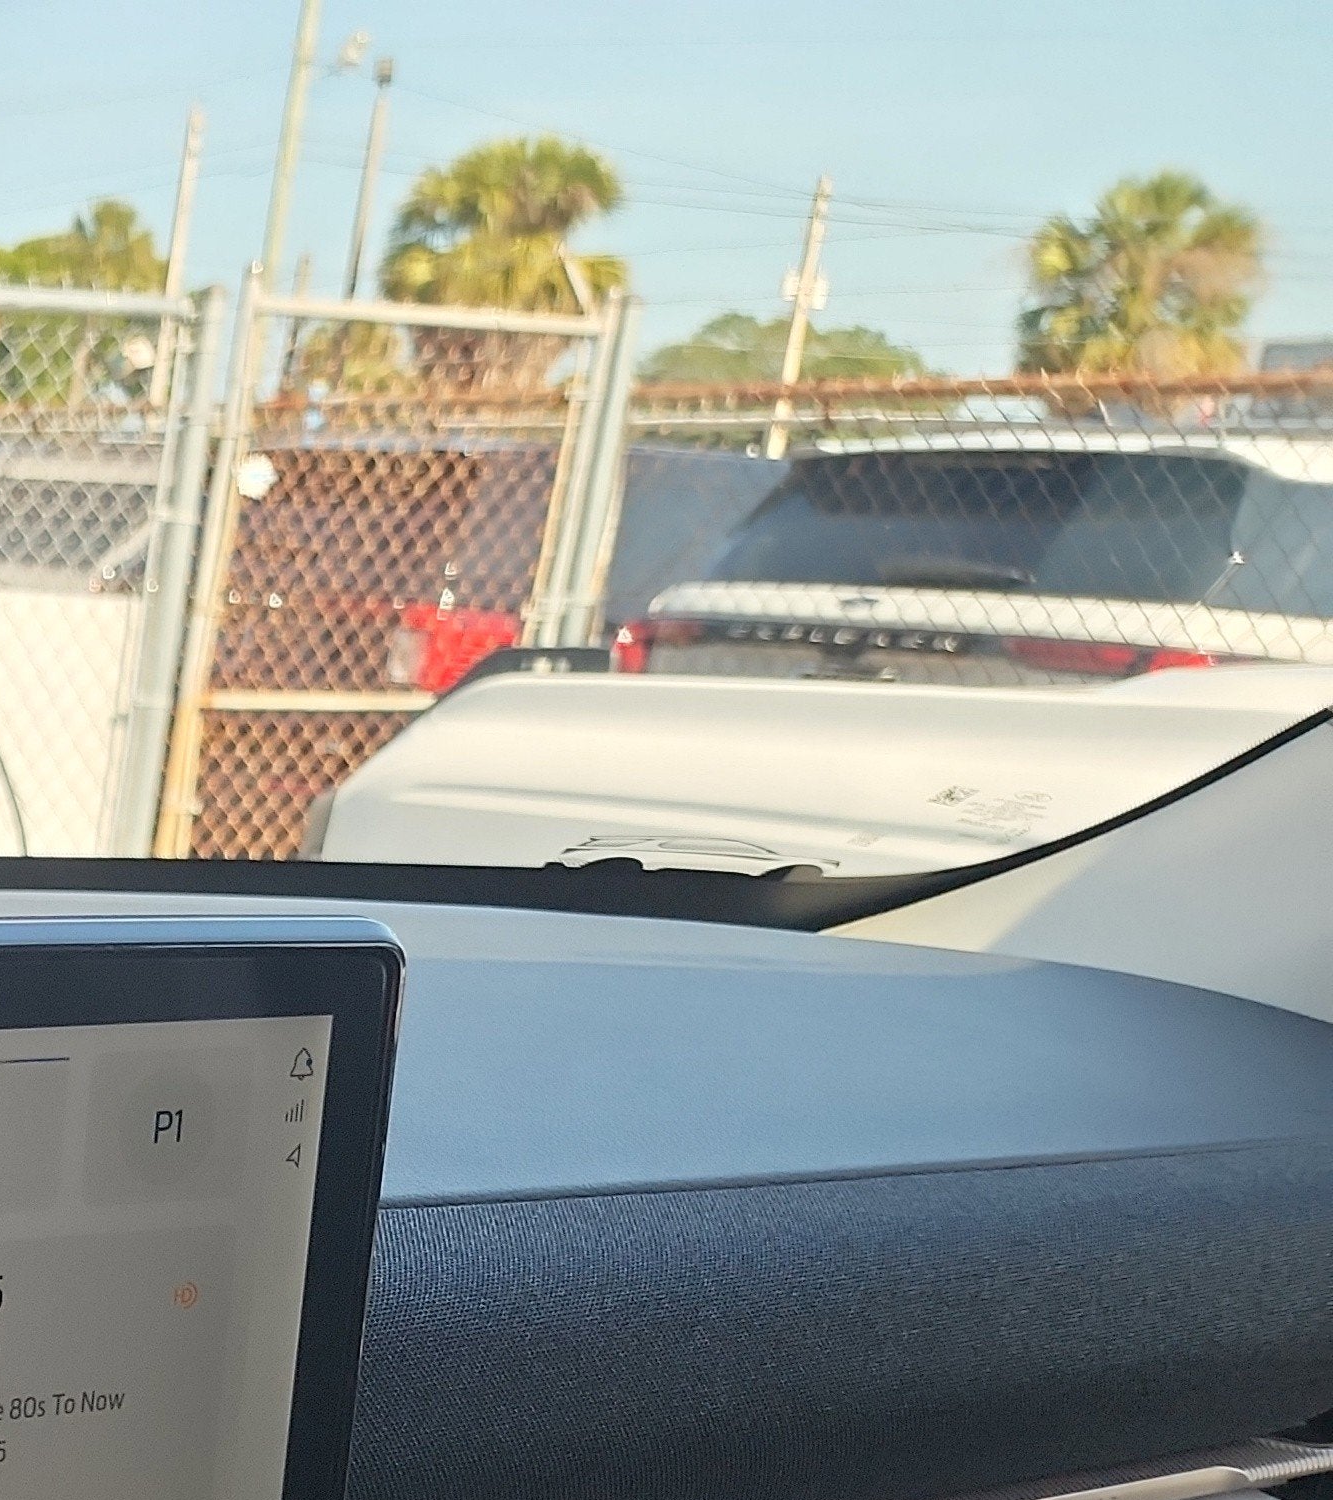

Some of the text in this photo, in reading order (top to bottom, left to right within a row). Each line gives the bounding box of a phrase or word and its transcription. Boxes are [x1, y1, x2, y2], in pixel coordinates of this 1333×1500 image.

[153, 1109, 183, 1144] P1
[9, 1396, 46, 1421] 80s
[52, 1393, 75, 1416] To
[82, 1387, 125, 1413] Now
